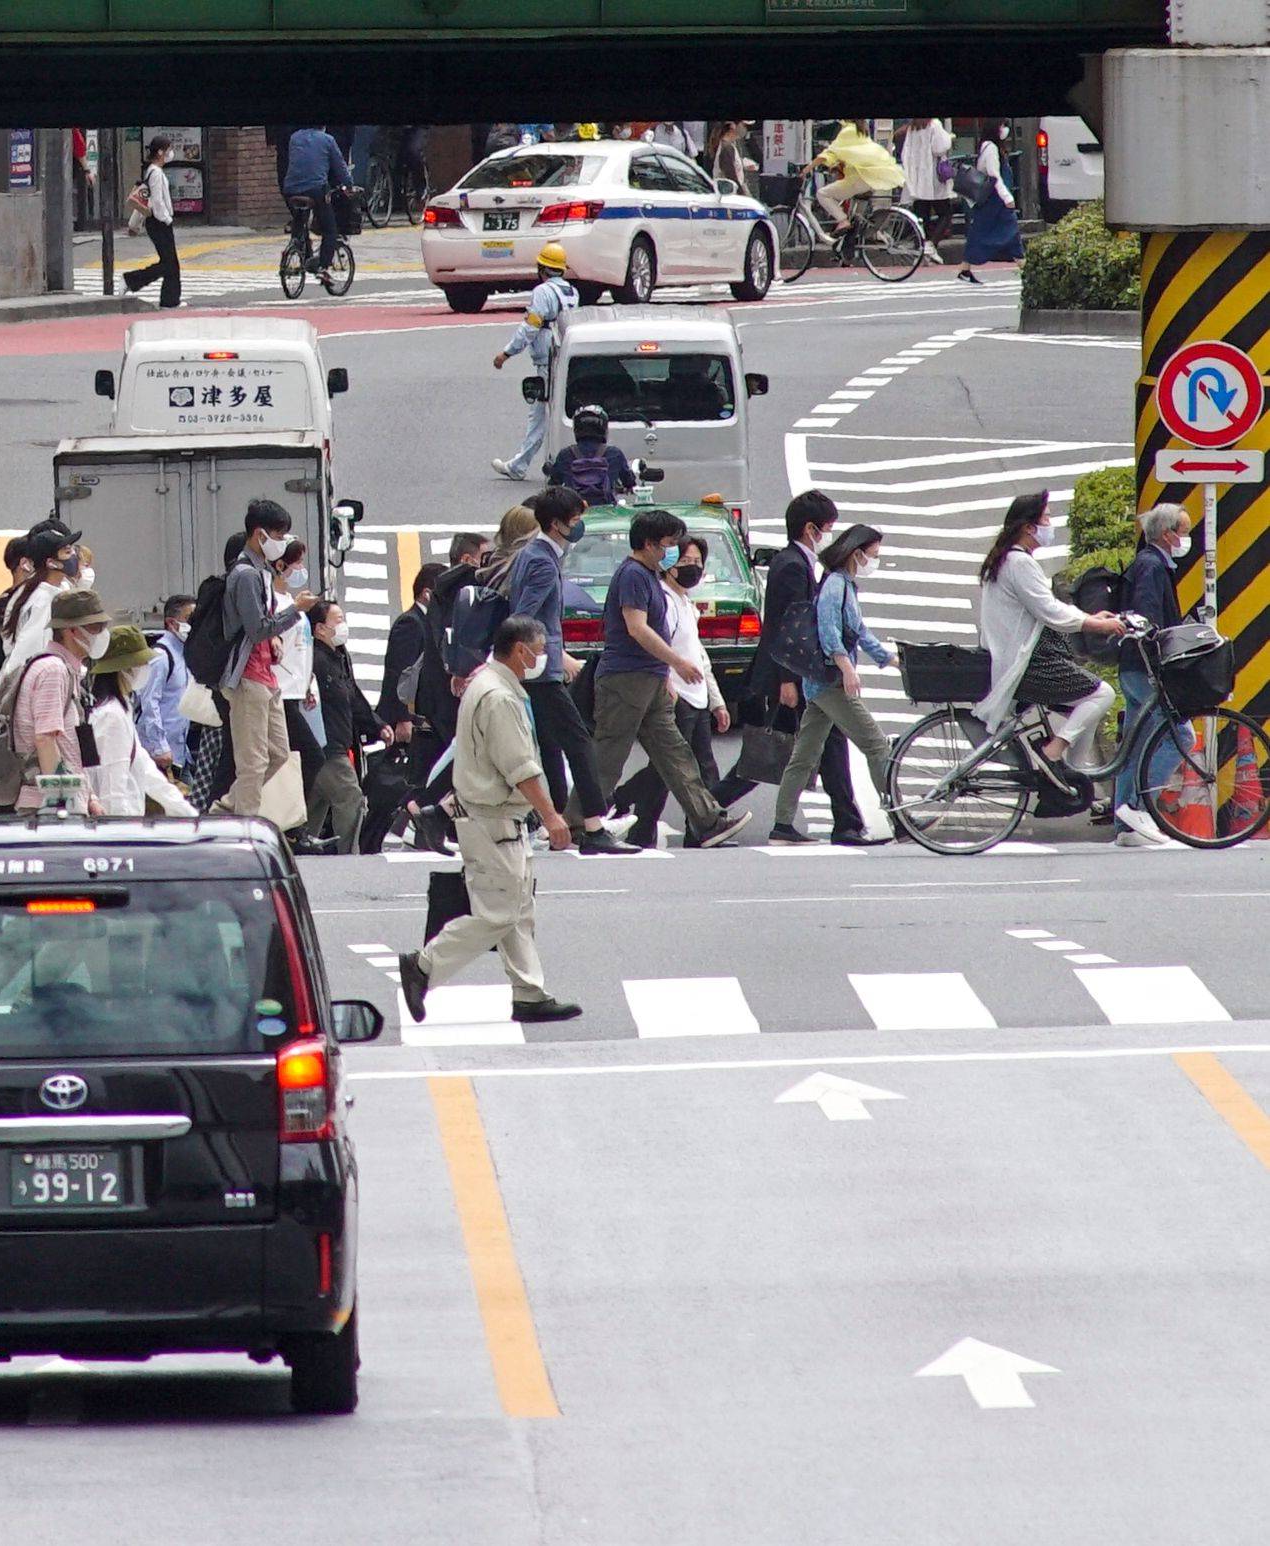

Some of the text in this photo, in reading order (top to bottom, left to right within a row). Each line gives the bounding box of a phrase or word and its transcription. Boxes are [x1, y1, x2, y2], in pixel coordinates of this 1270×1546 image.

[201, 385, 274, 407] 津多屋
[83, 857, 134, 872] 6971
[32, 1172, 118, 1203] 99-12
